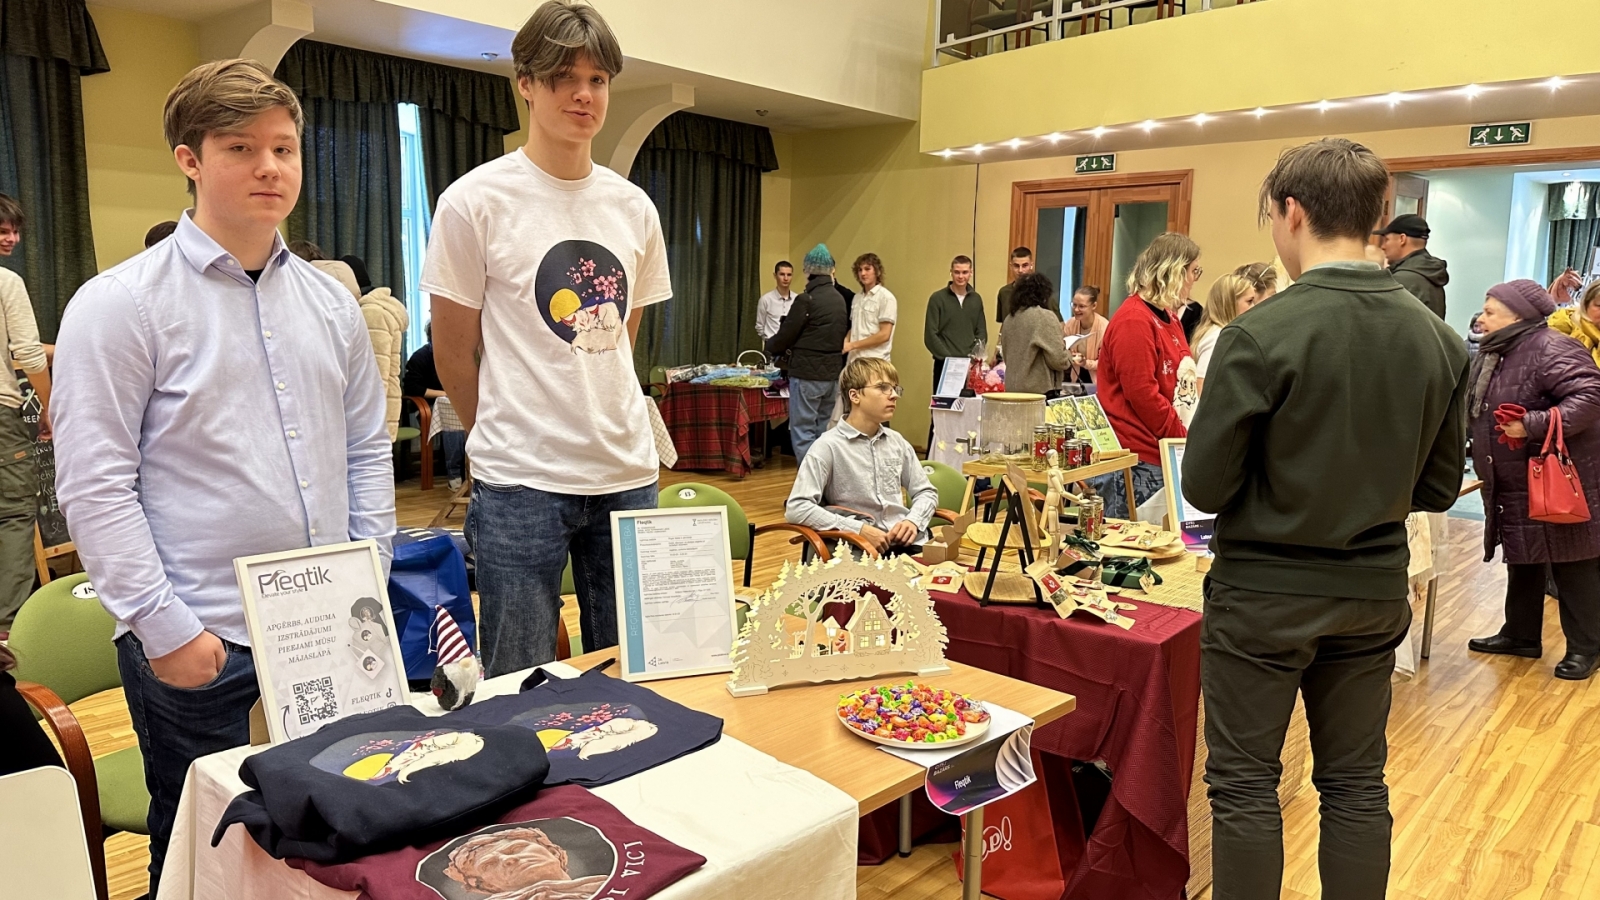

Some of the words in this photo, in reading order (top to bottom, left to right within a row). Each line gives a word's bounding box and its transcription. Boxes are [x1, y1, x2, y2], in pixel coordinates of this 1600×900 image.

[622, 524, 634, 569] APLIECĪBA
[257, 565, 333, 594] Fleqtik
[280, 589, 291, 597] your
[304, 613, 336, 625] AUDUMA
[277, 625, 332, 642] IZSTRĀDĀJUMI
[278, 641, 314, 654] PIEEJAMI
[315, 636, 336, 646] MŪSU
[288, 648, 331, 664] MĀJASLAPĀ
[351, 691, 382, 705] FLEQTIK
[954, 775, 972, 790] Fleqtik
